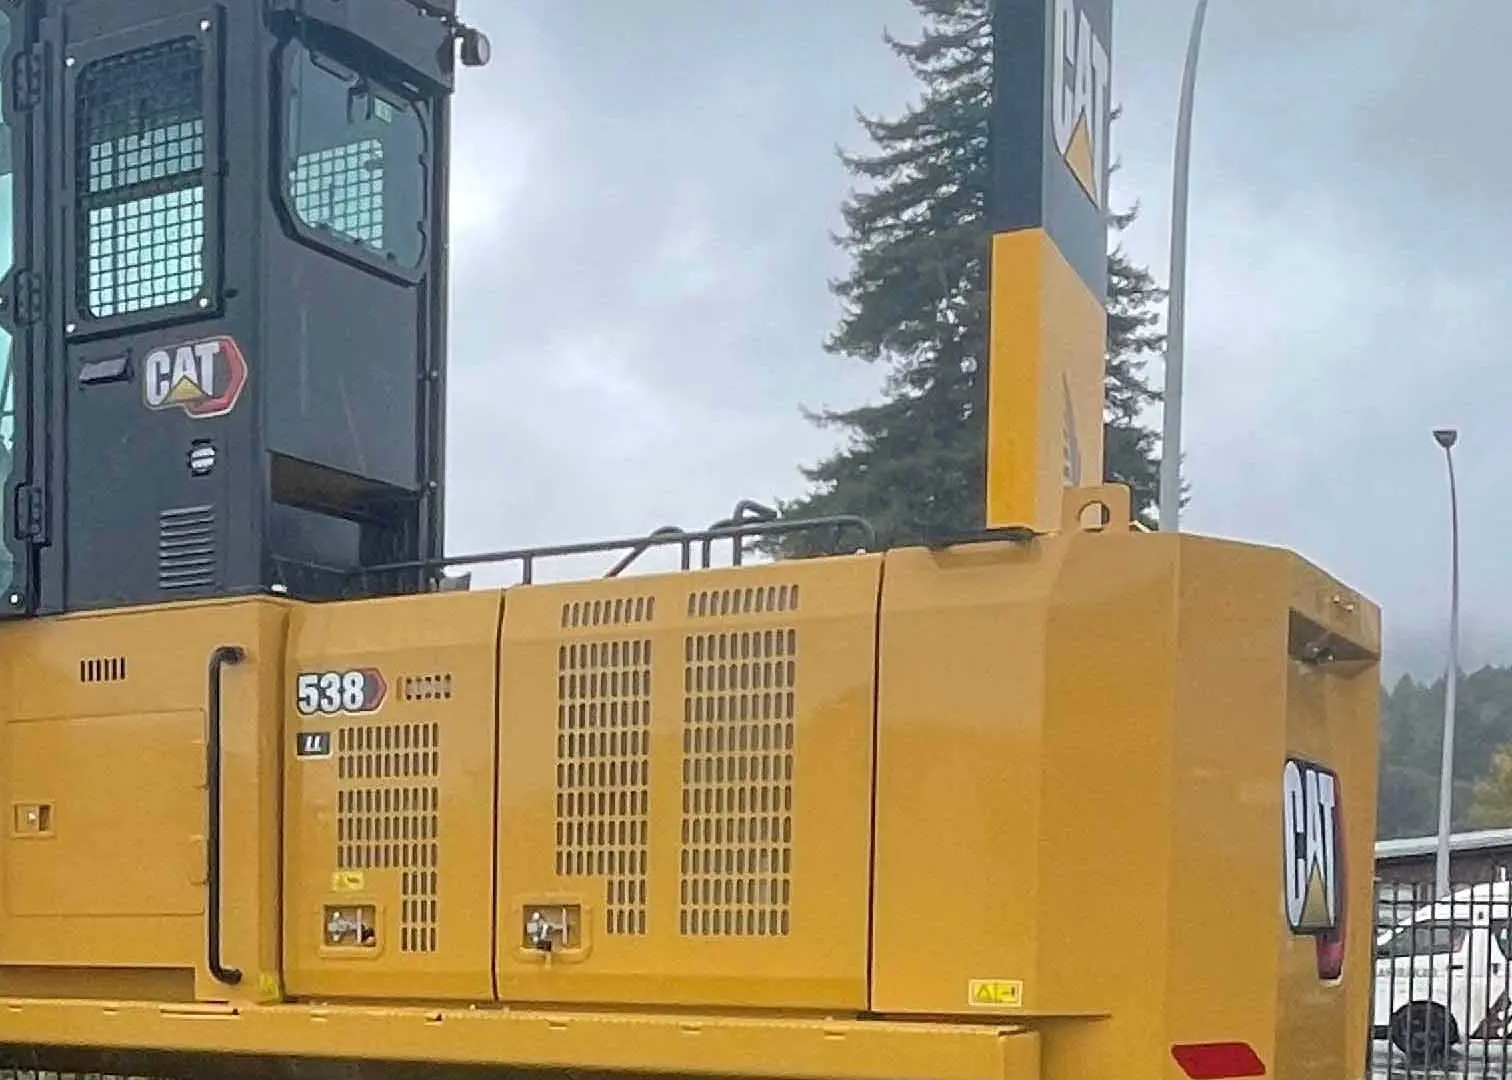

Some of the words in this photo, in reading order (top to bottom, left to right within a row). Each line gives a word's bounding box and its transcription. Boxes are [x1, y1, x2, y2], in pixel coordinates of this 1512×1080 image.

[1052, 0, 1109, 212] CAT
[146, 341, 220, 405] CAT
[298, 671, 364, 714] 538
[1283, 760, 1336, 927] CAT
